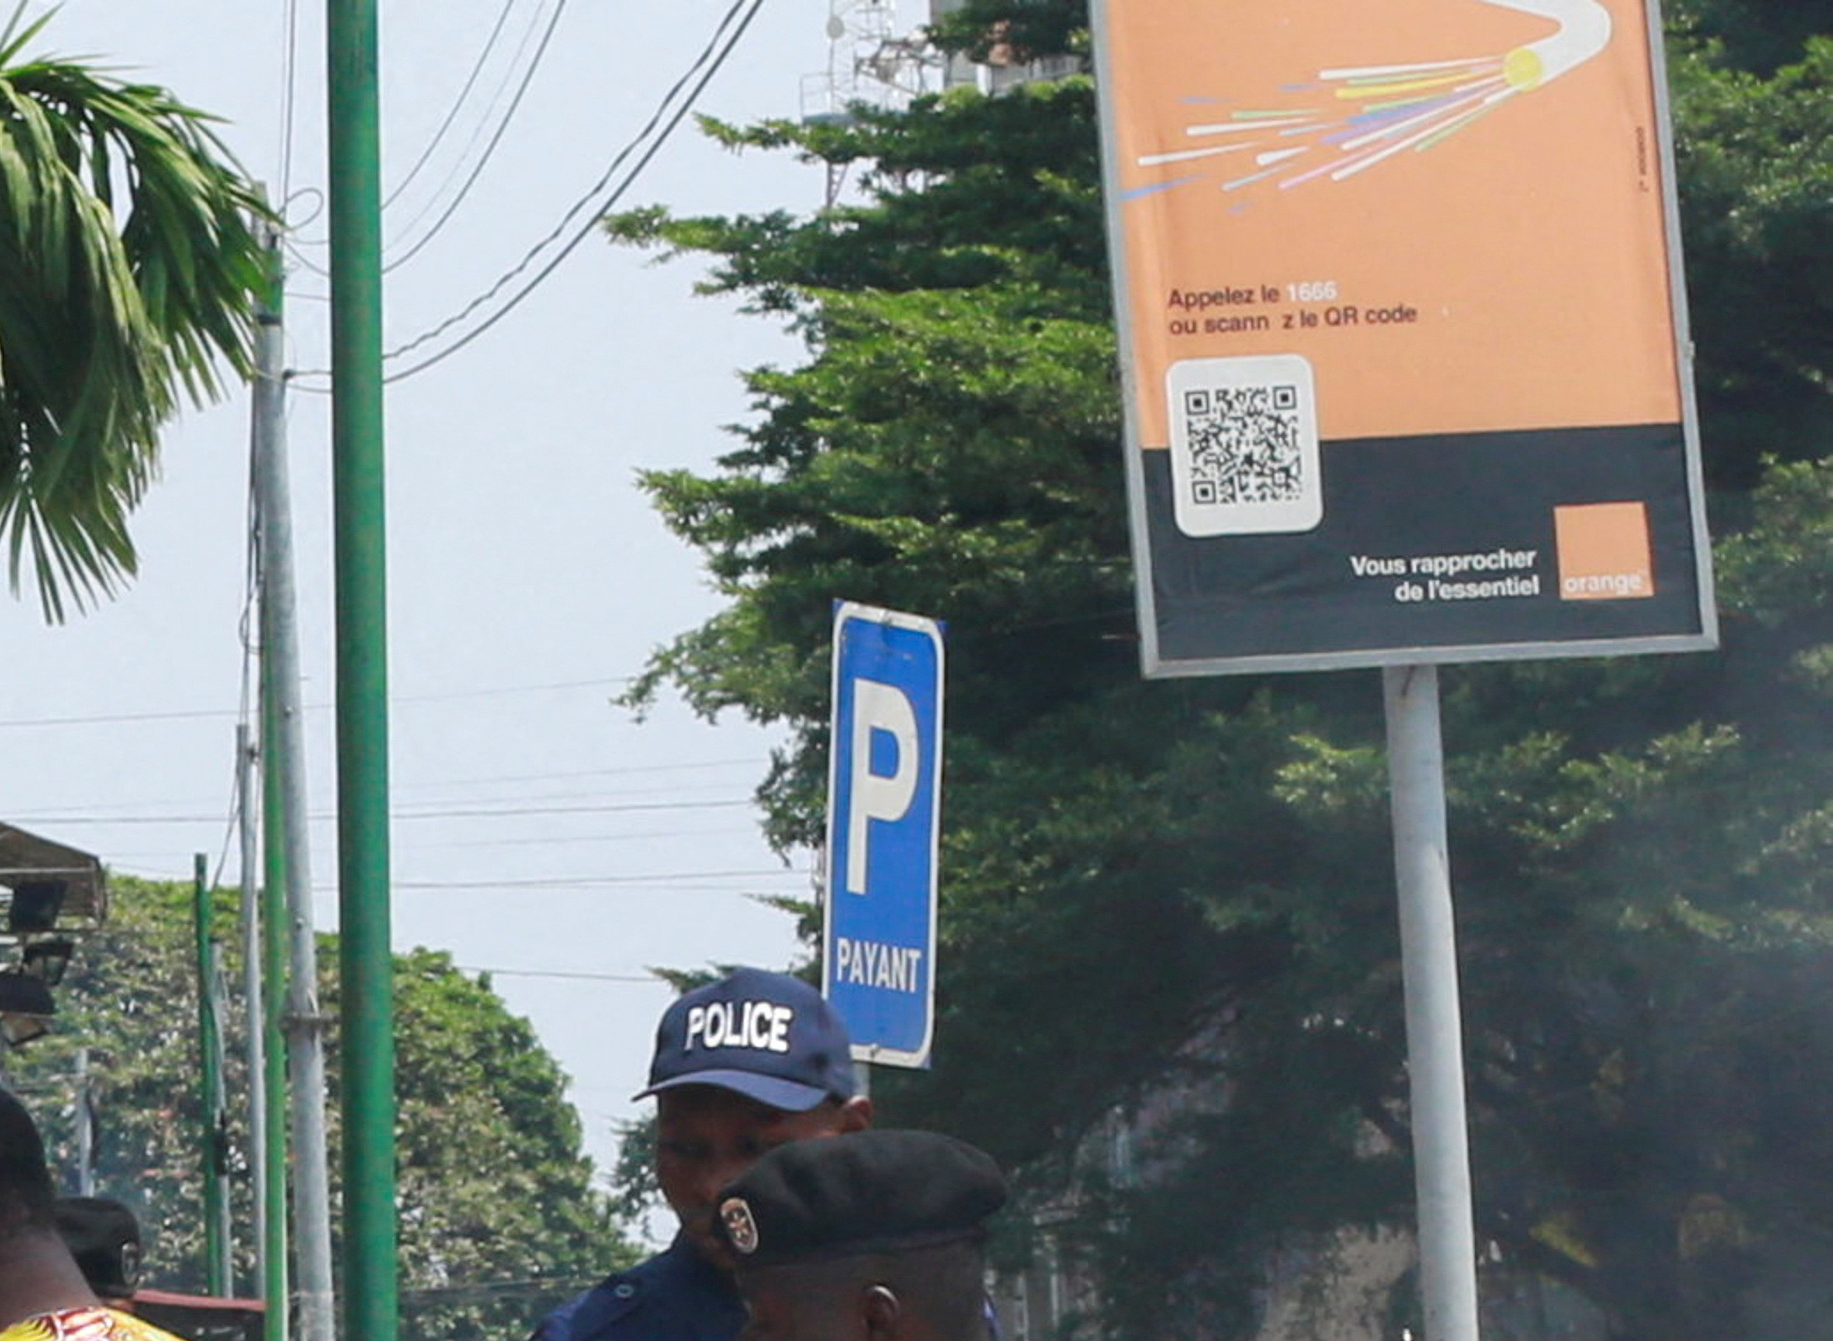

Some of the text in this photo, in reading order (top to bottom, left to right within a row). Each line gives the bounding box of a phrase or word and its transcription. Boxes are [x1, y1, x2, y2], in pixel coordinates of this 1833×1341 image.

[1168, 287, 1254, 311] Appelez
[1261, 285, 1280, 303] le
[1169, 320, 1197, 335] ou
[1300, 309, 1318, 328] le
[1324, 306, 1358, 327] QR
[1365, 304, 1418, 324] code
[1350, 548, 1537, 577] Vous rapprocher
[1395, 575, 1540, 602] de l'essentiel
[1564, 573, 1643, 595] orange
[846, 678, 920, 895] P
[836, 937, 923, 994] PAYANT
[686, 1001, 793, 1053] POLICE
